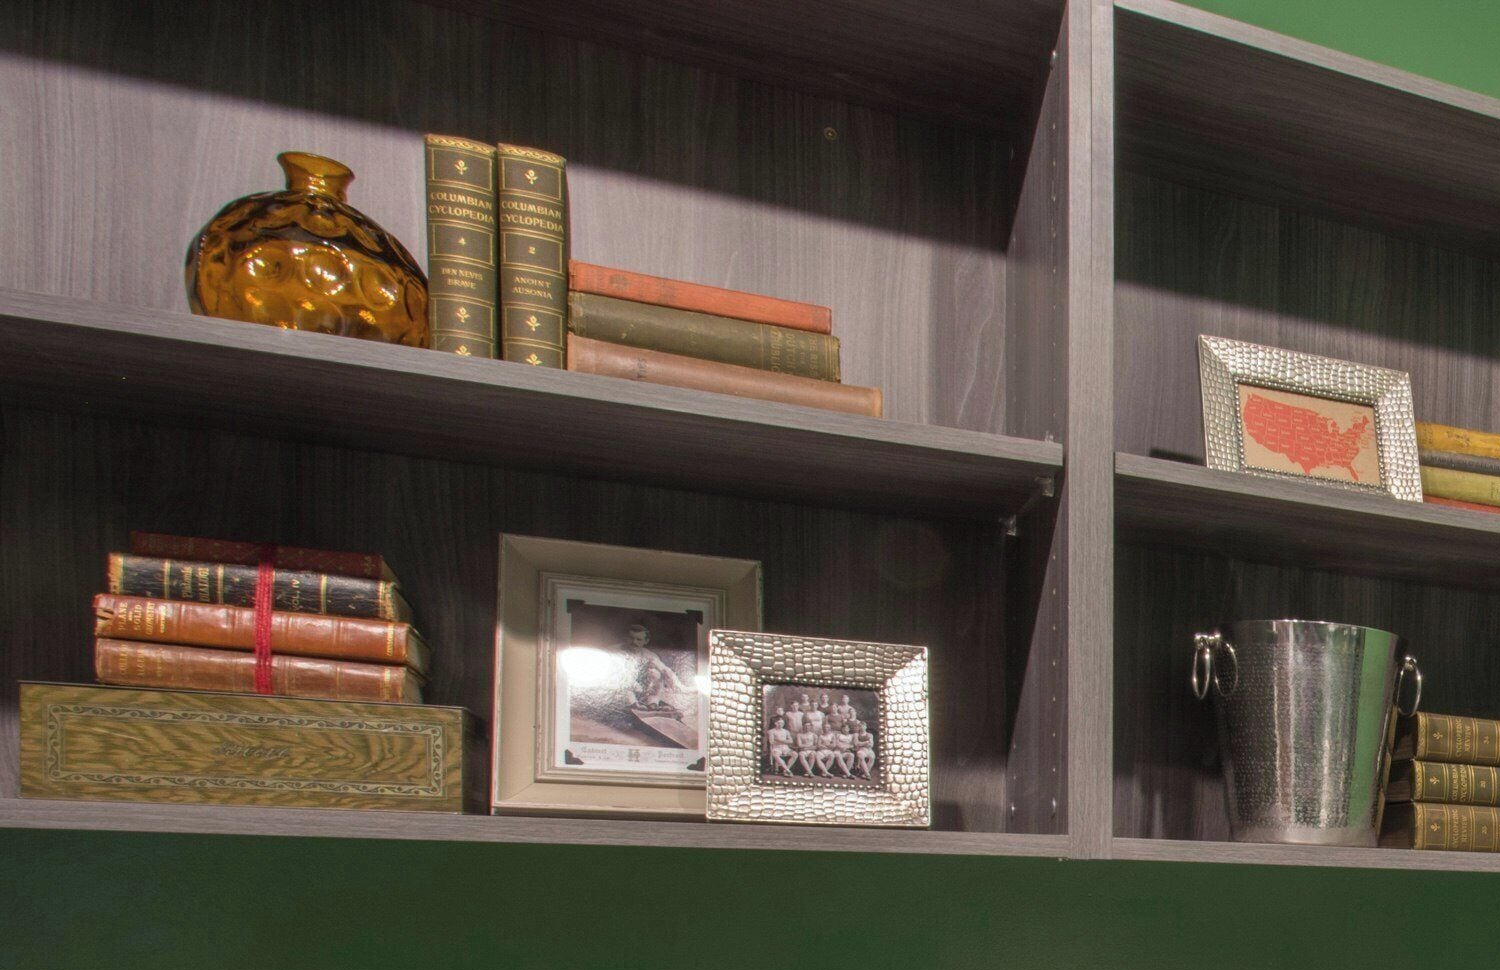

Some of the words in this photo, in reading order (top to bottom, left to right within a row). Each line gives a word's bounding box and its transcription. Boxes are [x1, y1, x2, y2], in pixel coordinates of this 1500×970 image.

[430, 192, 492, 211] COLUMBIAN
[501, 200, 562, 219] COLUMBIAN
[429, 205, 494, 225] CYCLOPEDIA
[501, 213, 564, 233] CYCLOPEDIA
[528, 246, 537, 255] 2
[447, 278, 476, 290] BRAVE
[514, 276, 551, 288] ANOINT
[513, 286, 552, 300] AUSONIA
[1464, 725, 1472, 752] REVIEW
